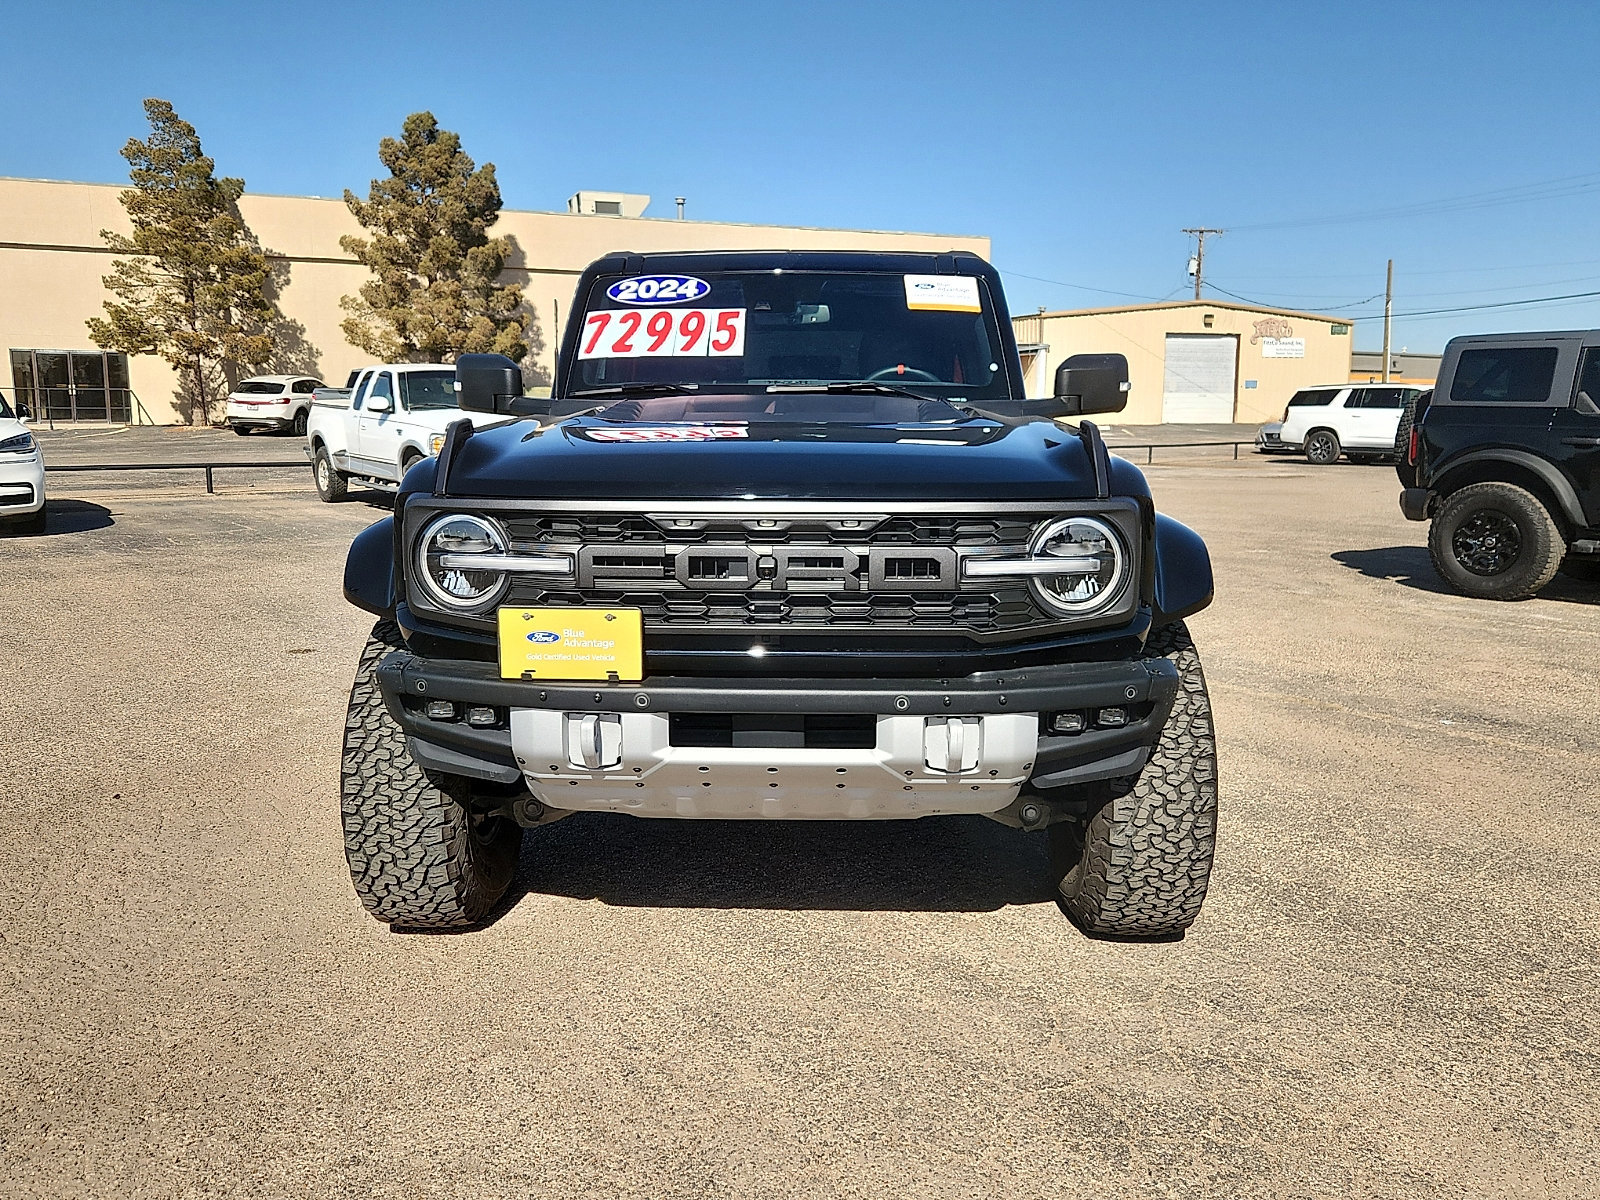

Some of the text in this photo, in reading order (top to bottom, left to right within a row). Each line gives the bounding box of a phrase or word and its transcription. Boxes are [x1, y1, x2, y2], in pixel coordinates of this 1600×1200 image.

[616, 279, 699, 300] 2024
[584, 310, 741, 355] 72995
[577, 546, 957, 590] FORD
[563, 629, 585, 638] Blue
[563, 639, 615, 649] Advantage
